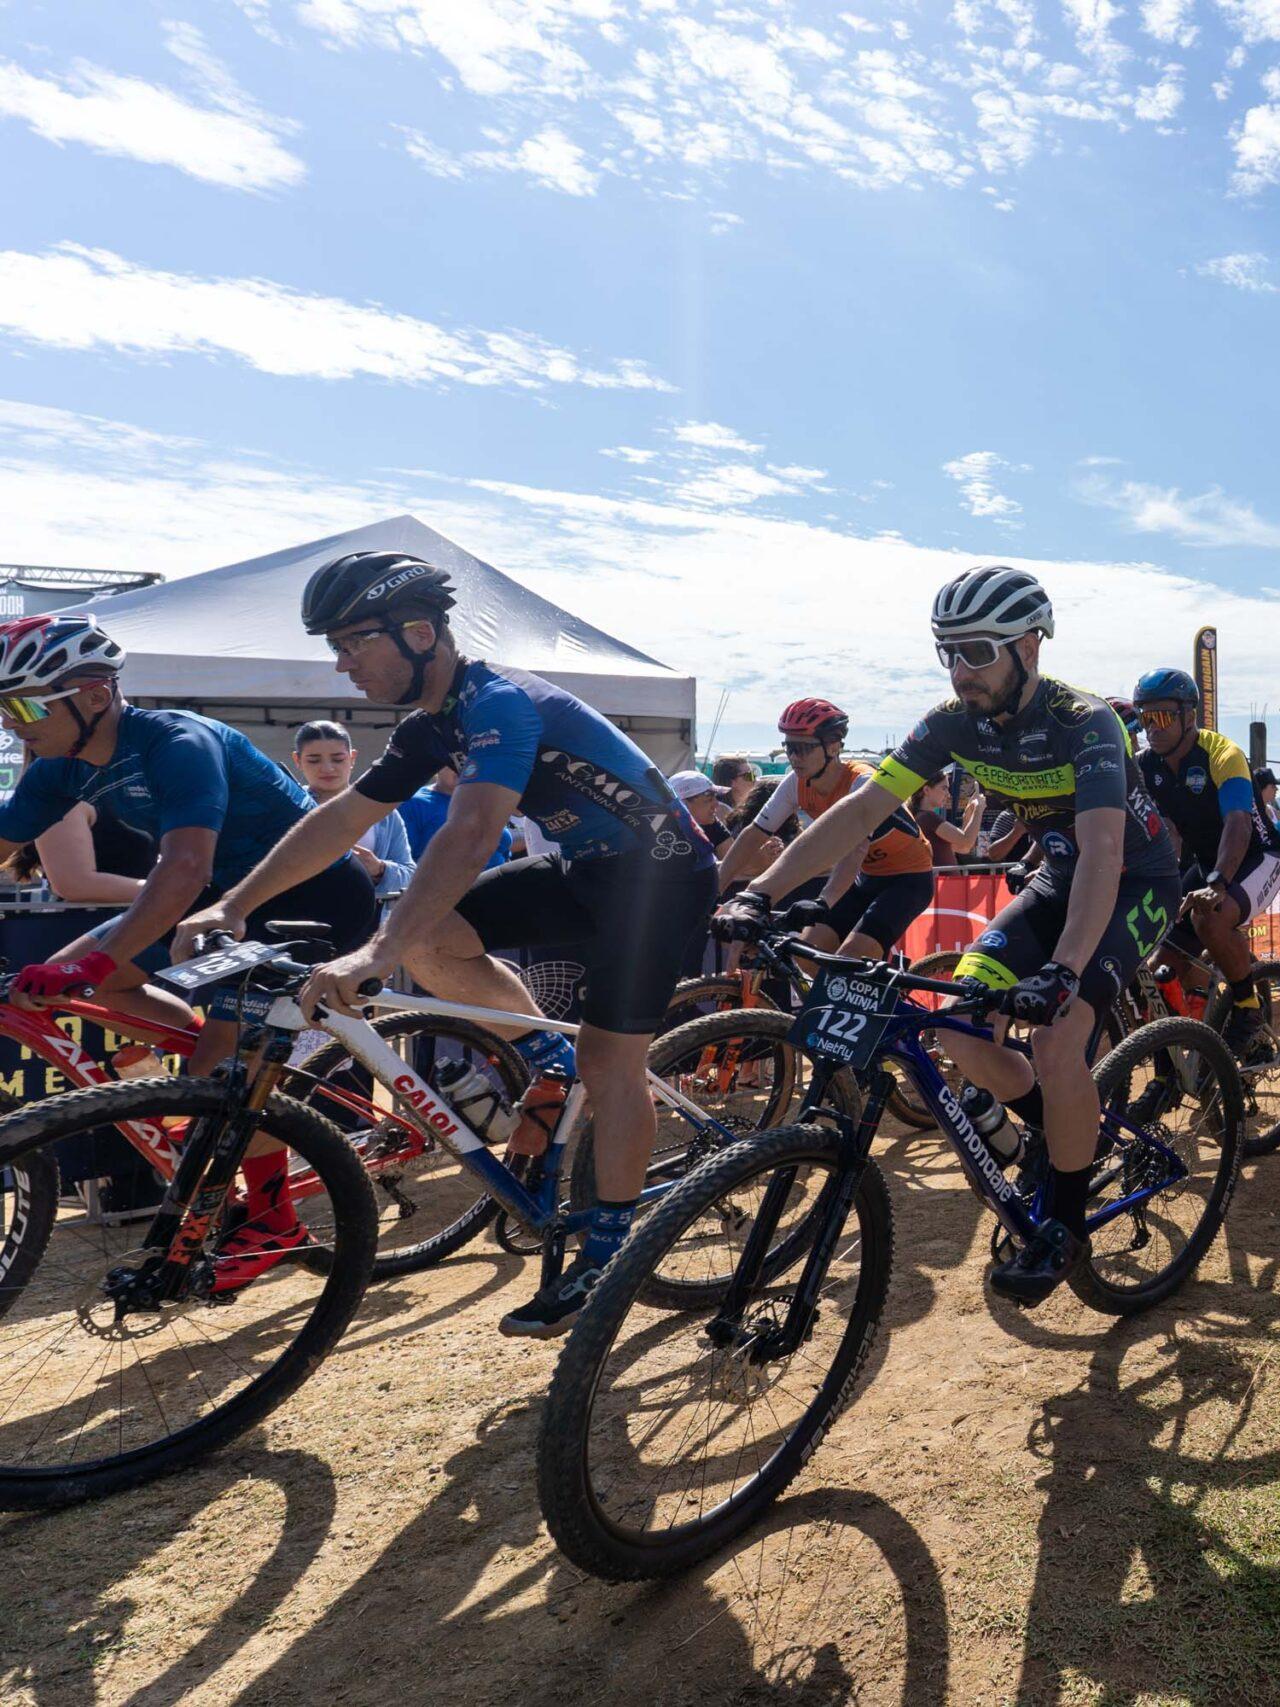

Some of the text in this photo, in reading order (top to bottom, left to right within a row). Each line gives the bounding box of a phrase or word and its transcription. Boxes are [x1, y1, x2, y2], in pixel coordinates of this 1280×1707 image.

[386, 566, 425, 588] GIRO
[990, 768, 1066, 786] PERFORMANCE
[554, 771, 618, 812] ANTONINA
[845, 991, 879, 1012] NINJA
[849, 980, 879, 999] COPA
[817, 1009, 868, 1043] 122
[817, 1036, 854, 1062] Netfly
[393, 1075, 460, 1138] CALOI
[938, 1085, 1012, 1202] cannondale
